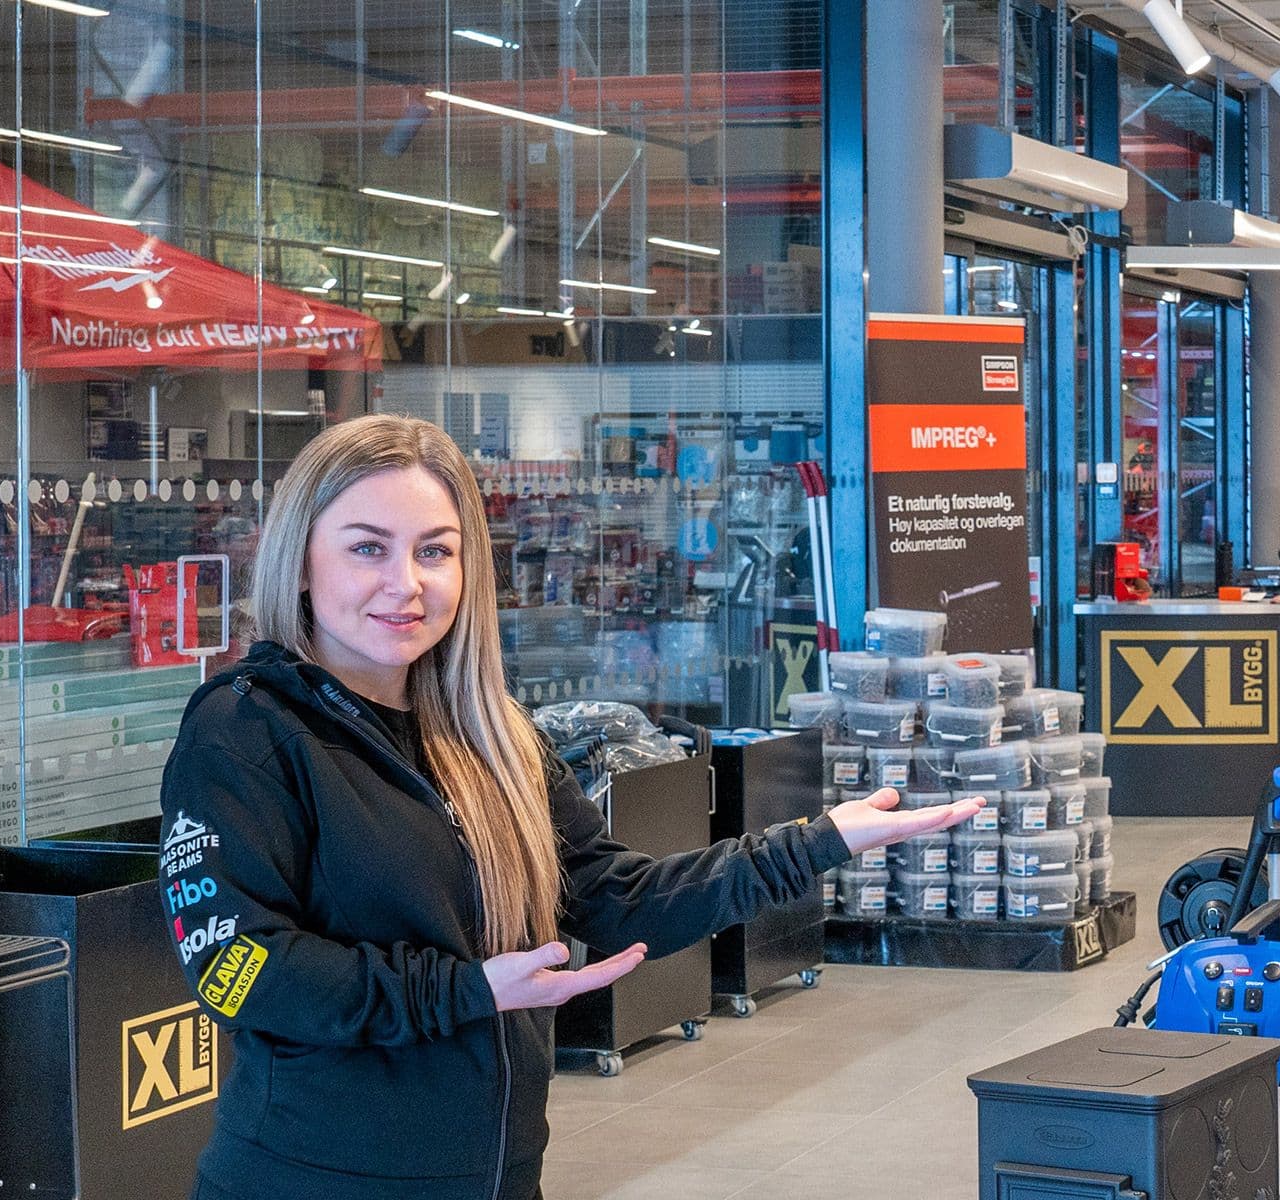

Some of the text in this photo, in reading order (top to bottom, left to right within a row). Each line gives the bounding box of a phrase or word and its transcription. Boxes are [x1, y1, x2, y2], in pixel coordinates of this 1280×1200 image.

[51, 316, 148, 352] Nothing
[156, 322, 200, 347] but
[201, 323, 287, 348] HEAVY
[888, 491, 1015, 514] Et naturlig førstevalg.
[889, 514, 1024, 535] Høy kapasitet og overlegen
[890, 535, 967, 553] dokumentation
[1113, 646, 1263, 728] XL
[1243, 646, 1263, 702] BYGG
[160, 834, 219, 869] MASONITE
[167, 851, 203, 877] BEAMS
[204, 942, 251, 1005] GLAVA
[227, 958, 260, 1010] ISOLASJON
[130, 1017, 211, 1112] XL
